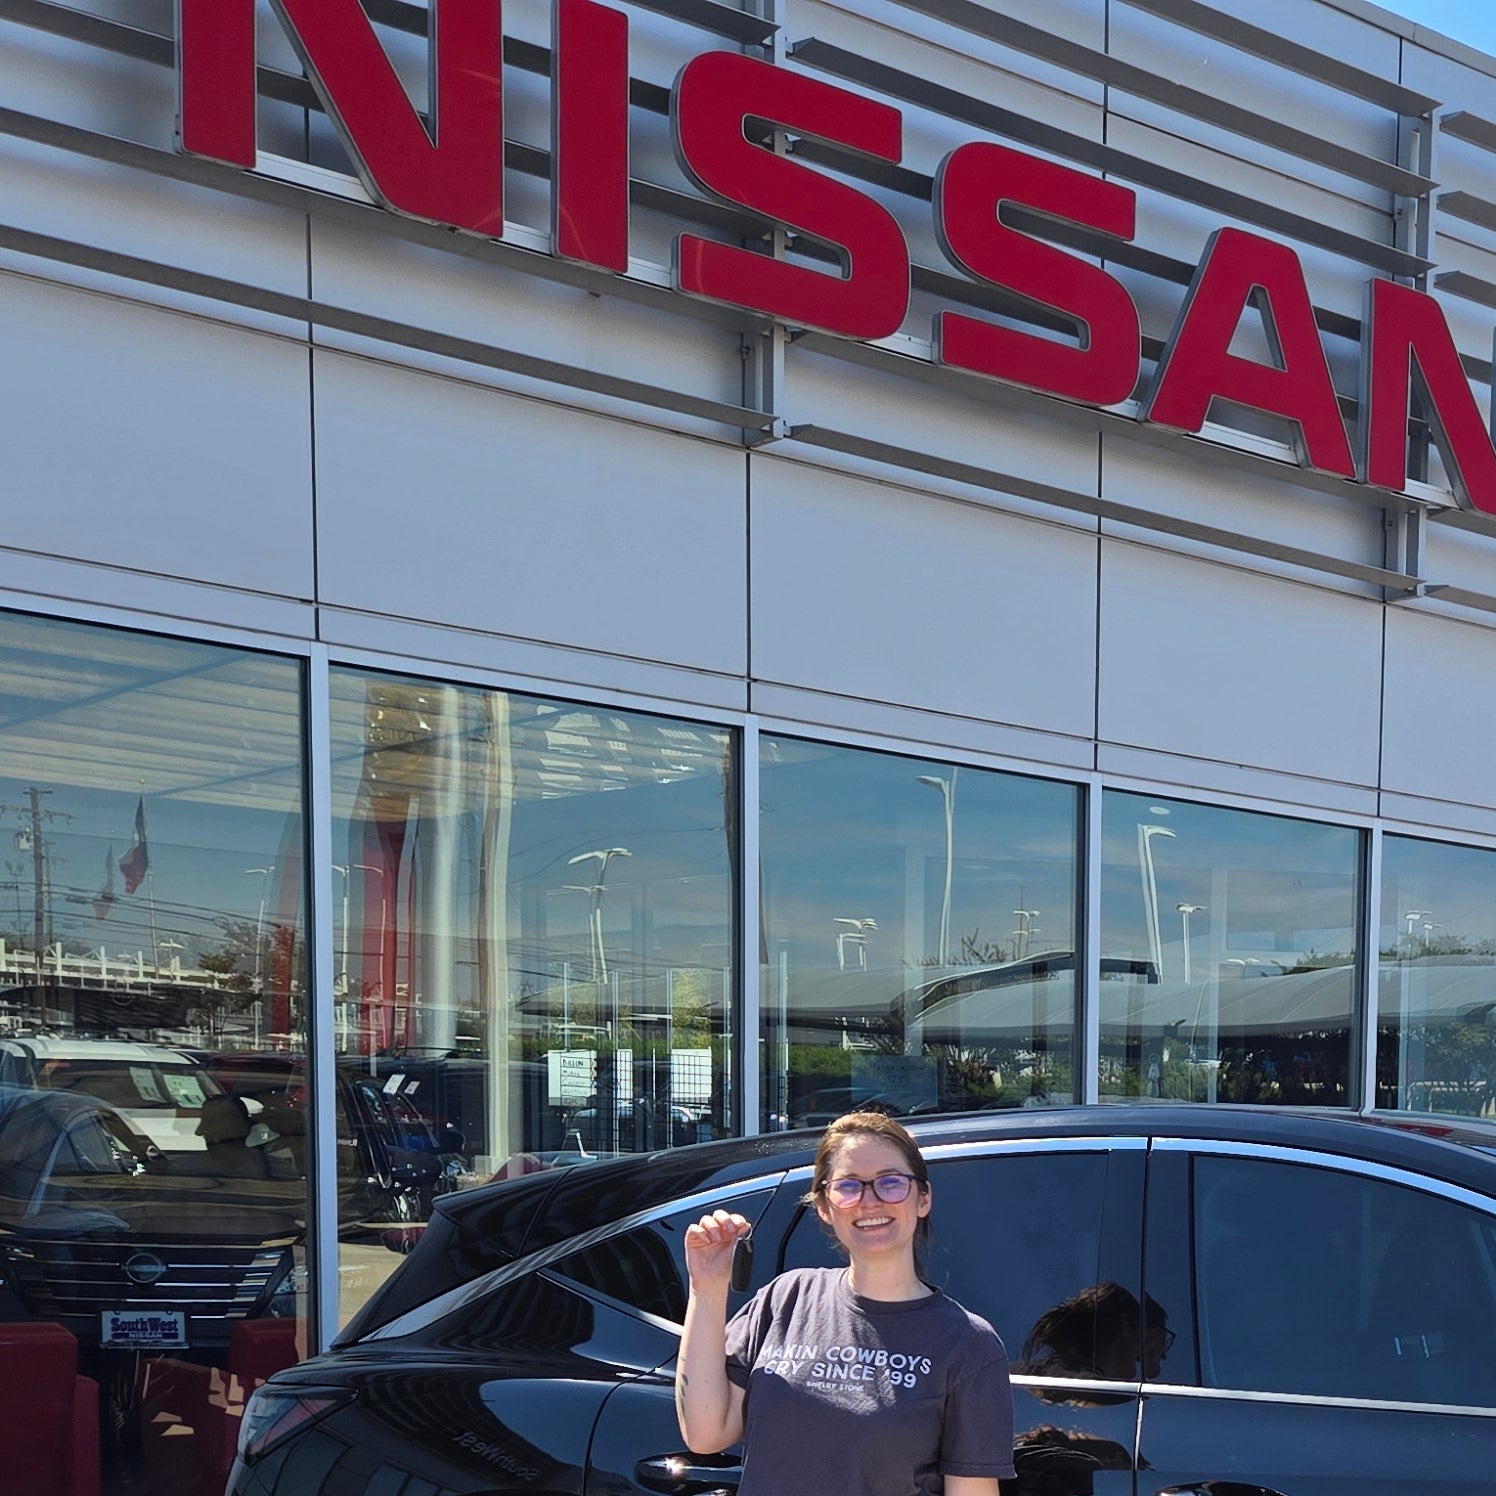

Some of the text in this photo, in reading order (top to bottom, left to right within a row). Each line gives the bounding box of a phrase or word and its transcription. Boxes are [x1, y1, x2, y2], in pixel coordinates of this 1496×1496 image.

[111, 1317, 179, 1333] SouthWest
[758, 1344, 932, 1375] MAKIN COWBOYS
[763, 1359, 805, 1375] CRY
[811, 1362, 876, 1381] SINCE
[806, 1381, 865, 1392] SHELBY STONE
